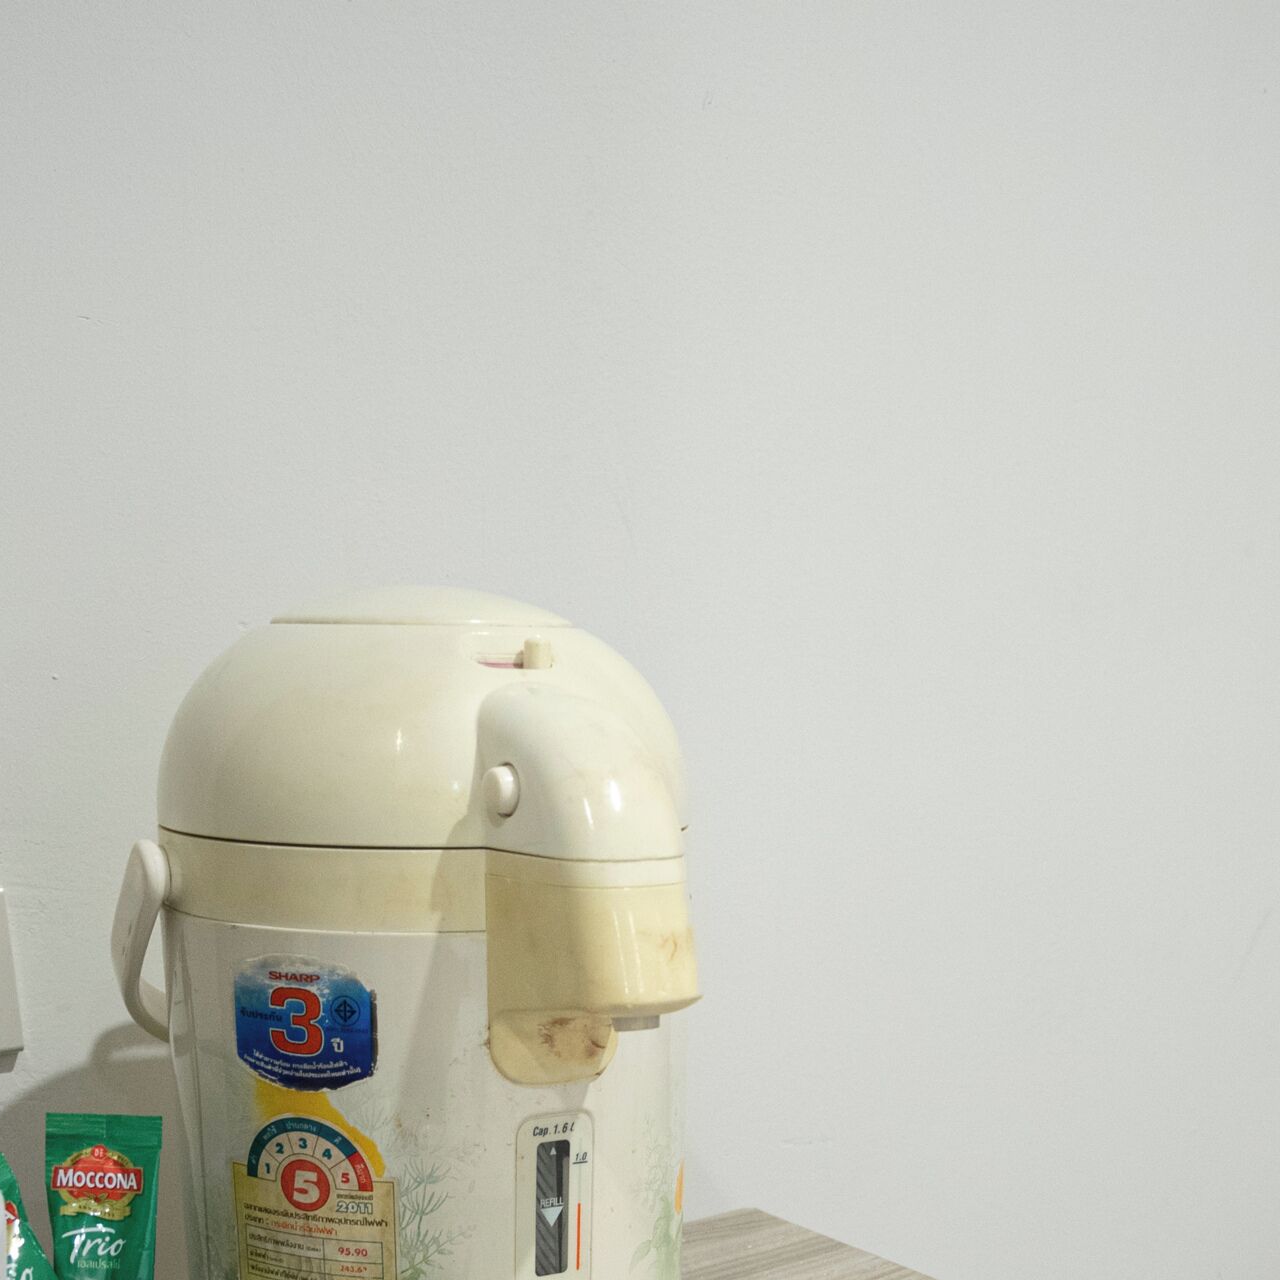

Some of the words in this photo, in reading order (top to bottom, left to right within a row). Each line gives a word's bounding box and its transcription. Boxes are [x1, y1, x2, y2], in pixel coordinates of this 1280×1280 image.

[268, 971, 320, 983] SHARP
[269, 985, 324, 1056] 3
[330, 1037, 344, 1053] ปี
[265, 1162, 271, 1174] 1
[275, 1142, 285, 1155] 2
[298, 1137, 308, 1149] 3
[322, 1148, 333, 1160] 4
[341, 1172, 350, 1184] 5
[575, 1152, 588, 1161] 1.0
[56, 1167, 138, 1190] MOCCONA
[293, 1169, 320, 1204] 5
[336, 1200, 374, 1215] 2011
[540, 1196, 564, 1208] REFILL
[61, 1223, 127, 1264] Trio
[337, 1246, 368, 1257] 95.90
